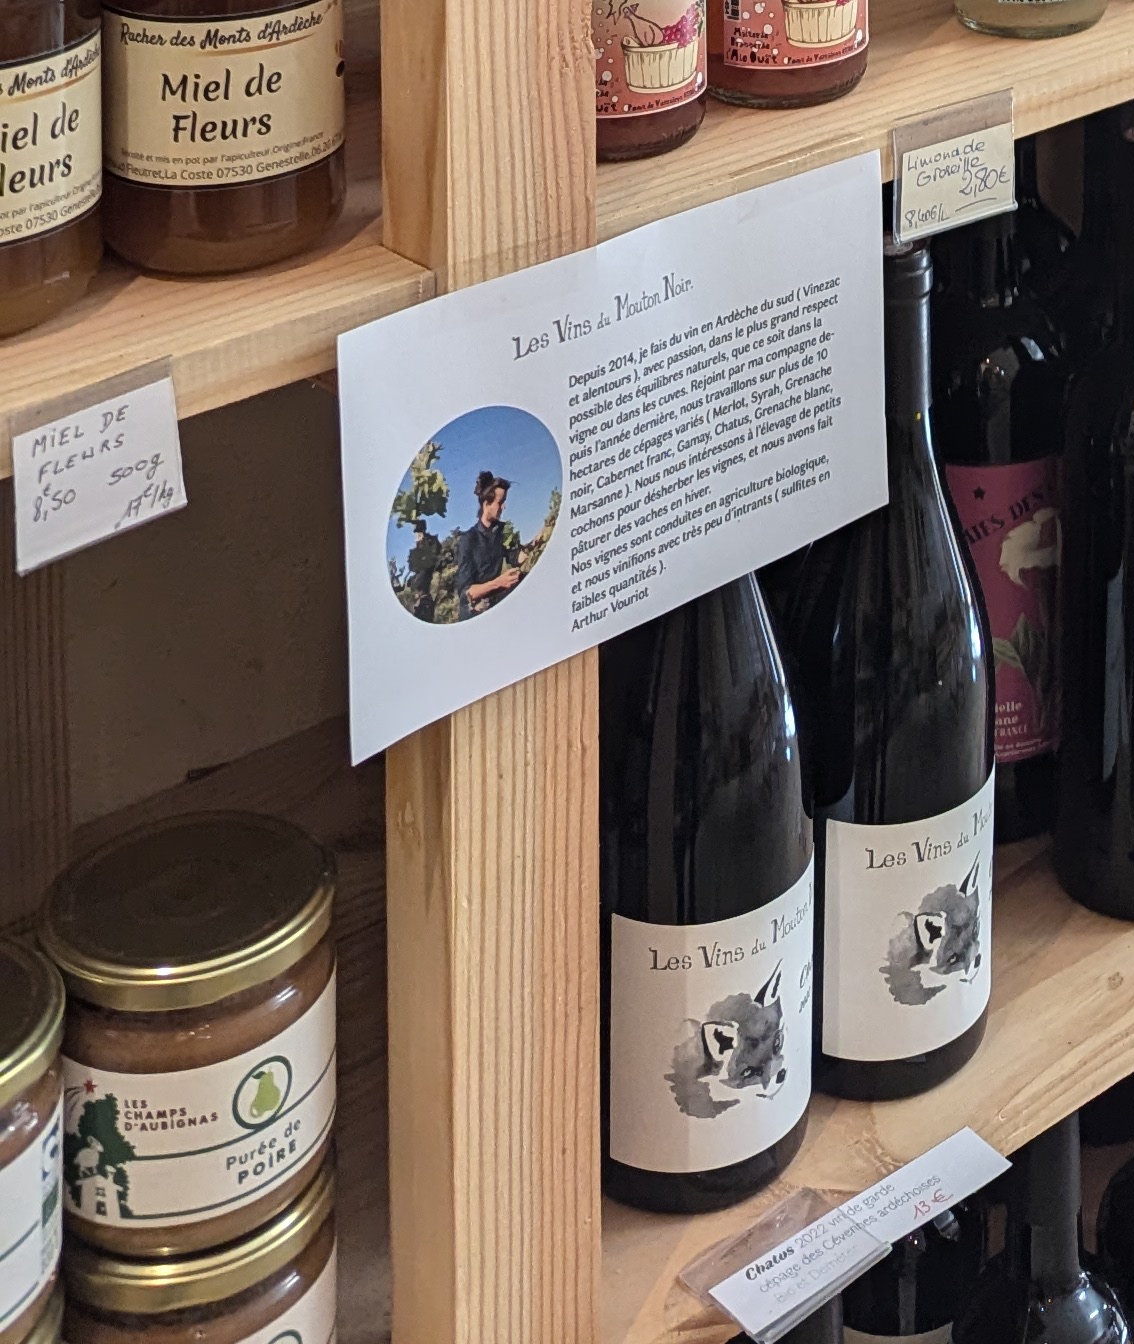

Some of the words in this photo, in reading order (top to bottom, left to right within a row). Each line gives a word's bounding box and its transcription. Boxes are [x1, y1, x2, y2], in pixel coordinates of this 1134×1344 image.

[120, 22, 167, 49] Rucher
[169, 24, 195, 50] des
[200, 24, 252, 51] Monts
[257, 10, 323, 43] d'Ardèche
[161, 69, 235, 103] Miel
[244, 63, 282, 96] de
[172, 109, 273, 144] Fleurs
[907, 139, 985, 172] Limonade
[917, 156, 984, 187] Groseille
[959, 165, 1010, 198] 2,80€
[512, 332, 550, 361] Les
[552, 313, 592, 343] Vins
[597, 312, 611, 330] du
[614, 293, 662, 322] Mouton
[662, 272, 694, 302] Noir.
[568, 366, 606, 389] Depuis
[608, 352, 637, 372] 2014,
[638, 347, 648, 364] je
[650, 339, 667, 356] fais
[669, 334, 682, 348] du
[684, 326, 699, 340] vin
[701, 320, 713, 334] en
[715, 304, 758, 328] Ardèche
[760, 299, 774, 312] du
[776, 290, 794, 307] sud
[802, 276, 841, 297] Vinezac
[100, 405, 129, 432] DE
[38, 434, 125, 484] FLEURS
[108, 453, 164, 486] 500g
[571, 606, 609, 633] Arthur
[610, 588, 650, 612] Vouriot
[865, 848, 907, 871] Les
[911, 838, 952, 865] Vins
[957, 830, 970, 850] du
[649, 947, 693, 972] Les
[698, 942, 745, 970] Vins
[751, 938, 767, 957] du
[124, 1099, 148, 1110] LES
[124, 1106, 187, 1121] CHAMPS
[225, 1135, 278, 1172] Purée
[283, 1118, 302, 1143] de
[745, 1246, 796, 1281] Chatus
[794, 1224, 828, 1249] 2022
[862, 1182, 896, 1209] garde
[759, 1263, 802, 1293] cépage
[802, 1247, 824, 1266] des
[877, 1174, 942, 1218] ardéchoises
